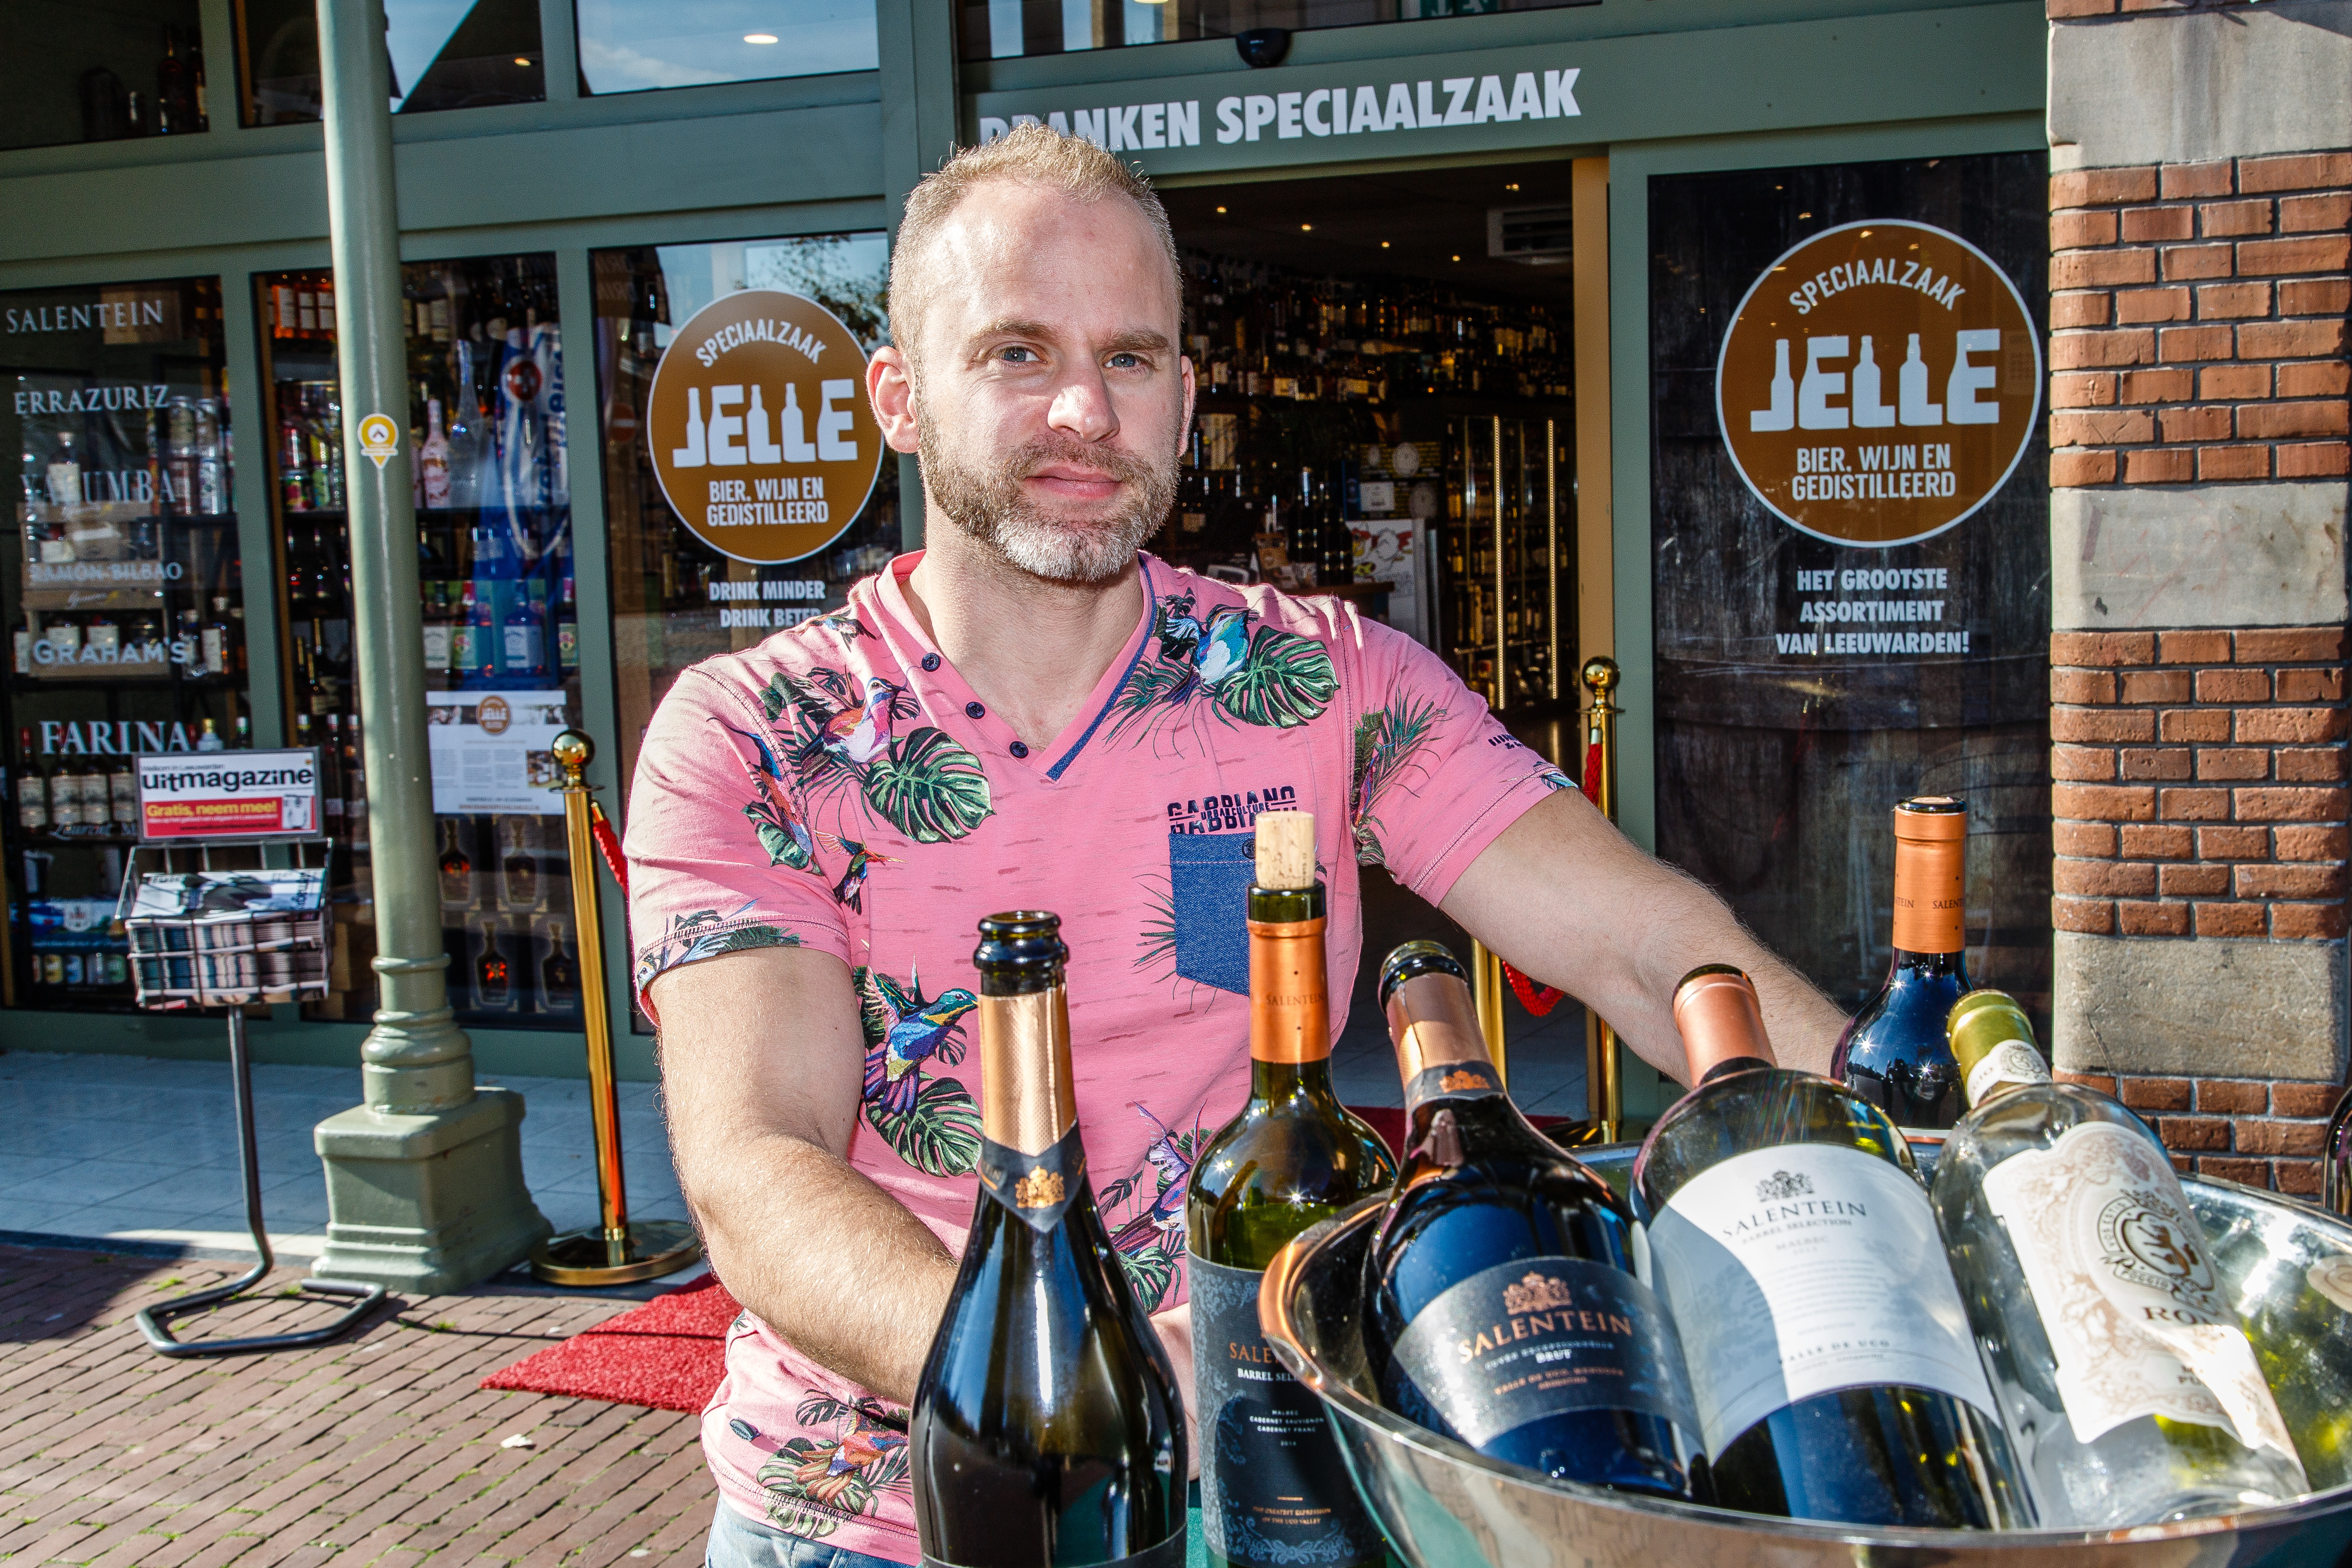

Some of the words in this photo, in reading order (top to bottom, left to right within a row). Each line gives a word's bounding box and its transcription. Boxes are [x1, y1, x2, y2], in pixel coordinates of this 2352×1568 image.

[979, 100, 1201, 151] DANKEN
[1217, 68, 1581, 144] SPECIAALZAAK
[1790, 258, 1965, 314] SPECIAALZAAK
[6, 300, 163, 334] SALENTEIN
[696, 319, 827, 367] SPECIAALZAAK
[1750, 329, 2000, 432] JELLE
[13, 384, 170, 415] ERRAZURIZ
[673, 379, 858, 468] JELLE
[1858, 445, 1916, 471] WIJN
[1923, 444, 1951, 469] EN
[754, 478, 799, 501] WIJN
[802, 477, 824, 499] EN
[1792, 472, 1956, 501] GEDISTILLEERD
[707, 501, 829, 527] GEDISTILLEERD
[709, 582, 760, 601] DRINK
[763, 580, 826, 600] MINDER
[1797, 570, 1835, 591] HET
[1841, 568, 1948, 590] GROOTSTE
[720, 608, 770, 628] DRINK
[1800, 600, 1945, 622] ASSORTIMENT
[33, 638, 188, 665] GRAHAM'S
[1776, 633, 1817, 653] VAN
[1824, 632, 1969, 654] LEEUWARDEN!
[40, 721, 191, 754] FARINA
[143, 768, 313, 792] uitmagazine
[146, 804, 194, 817] Gratis,
[195, 803, 239, 815] neem
[1723, 1200, 1866, 1241] SALENTEIN
[1787, 1219, 1852, 1230] SELECTION
[1458, 1311, 1632, 1364] SALENTEIN
[1229, 1341, 1279, 1364] SALE
[1535, 1349, 1572, 1364] BRUT
[1237, 1367, 1273, 1382] BARREL
[1249, 1416, 1282, 1425] CABERNET
[1257, 1425, 1291, 1433] CABERNET
